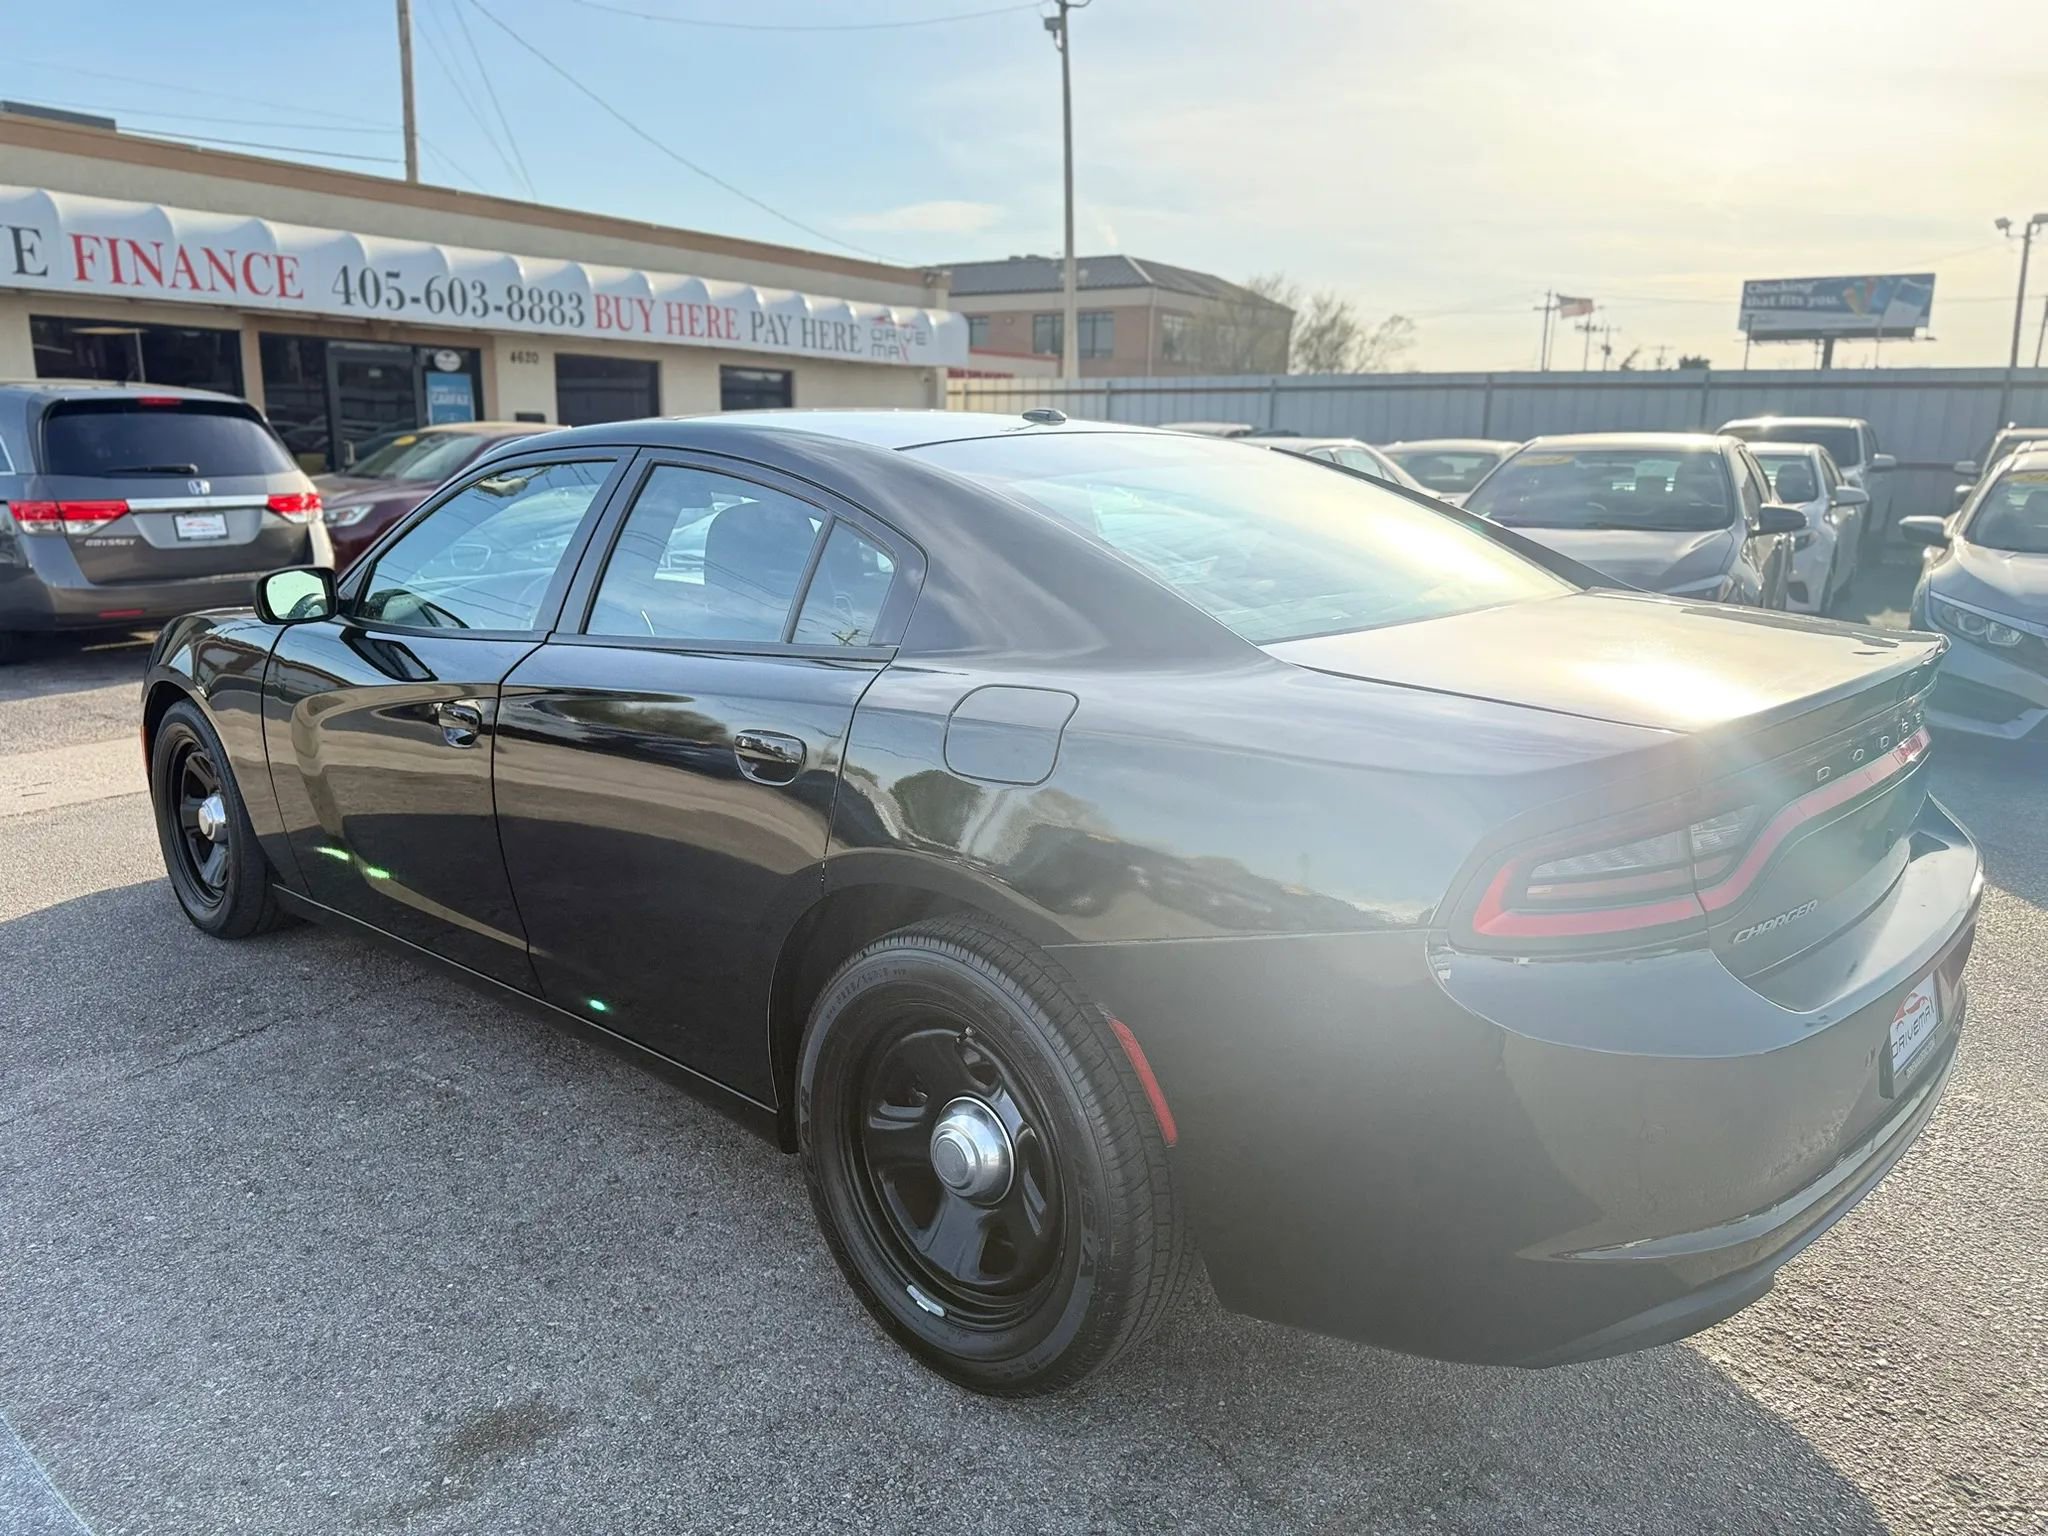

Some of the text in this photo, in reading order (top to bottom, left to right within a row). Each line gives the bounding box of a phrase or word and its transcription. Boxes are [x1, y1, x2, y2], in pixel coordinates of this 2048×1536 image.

[0, 224, 863, 354] E FINANCE 405-603-8883 BUY HERE PAY HERE
[1732, 899, 1819, 945] CHARGER
